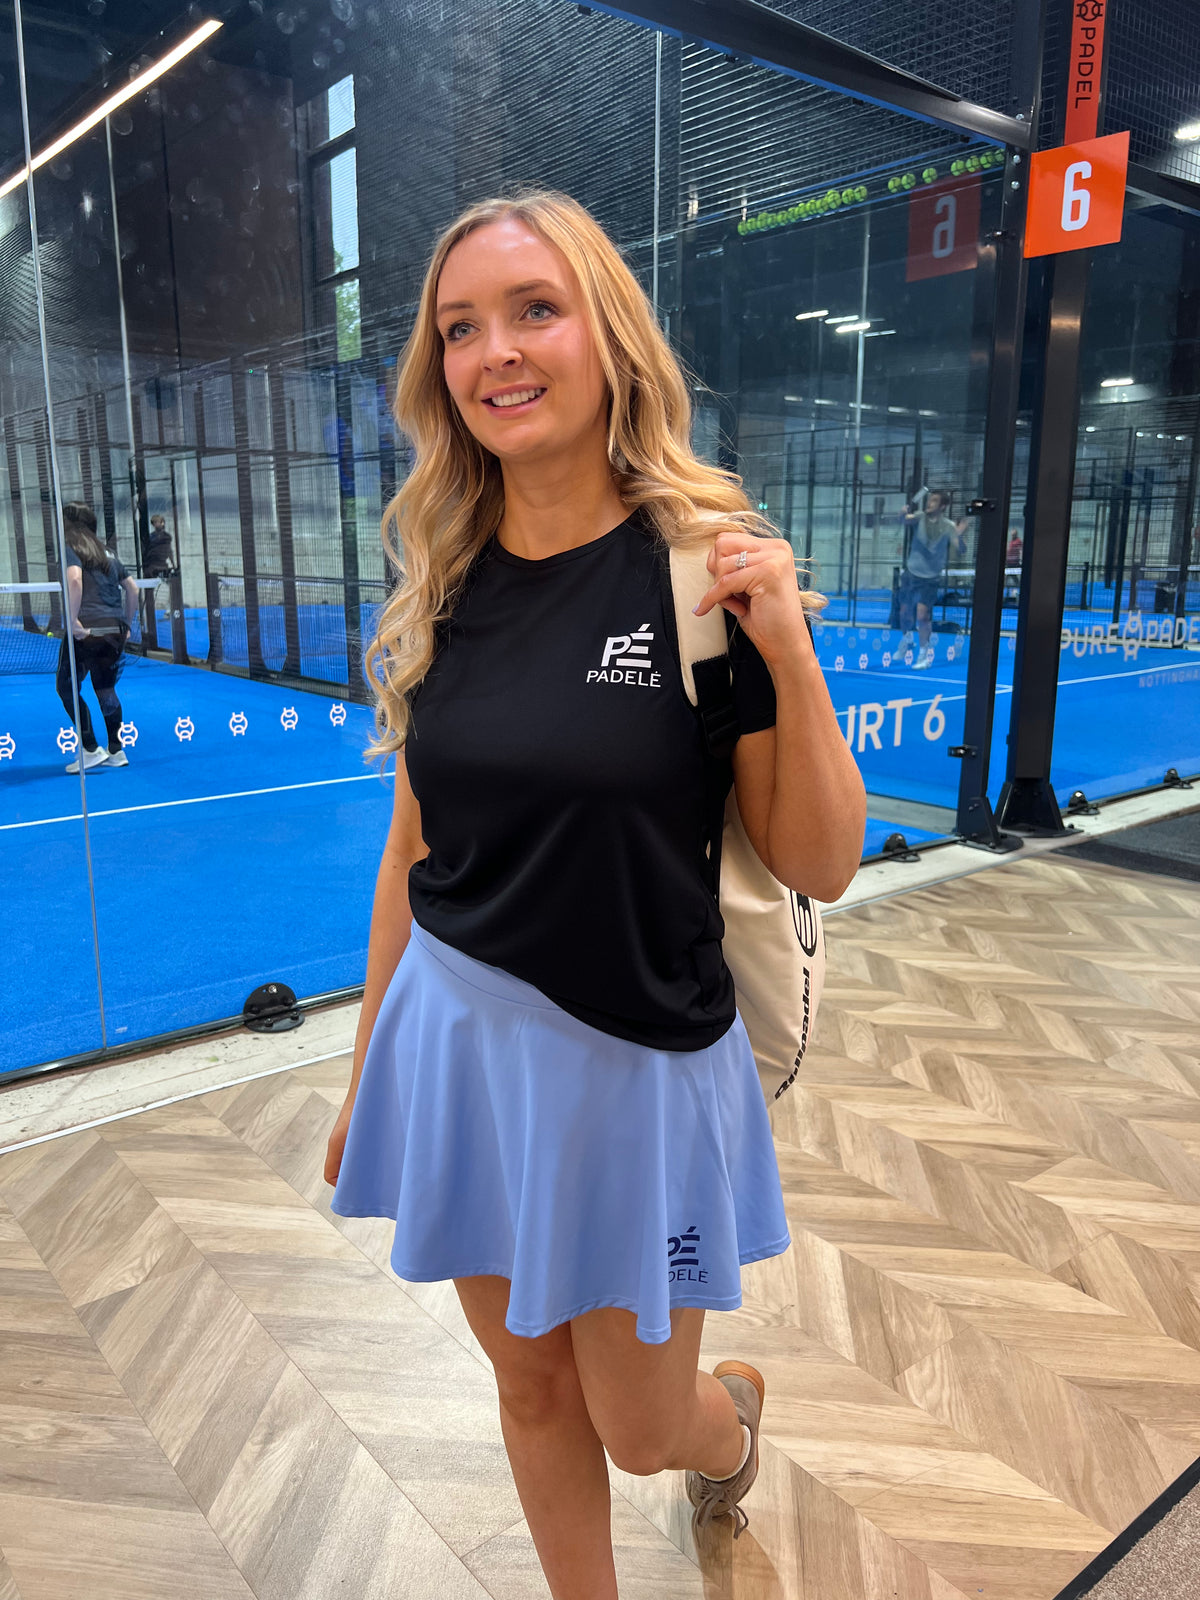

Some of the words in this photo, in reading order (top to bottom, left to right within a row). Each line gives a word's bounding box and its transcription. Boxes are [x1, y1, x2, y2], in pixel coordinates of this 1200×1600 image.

[1074, 27, 1096, 109] PADEL
[1061, 160, 1092, 232] 6
[1060, 622, 1119, 658] PURE
[923, 693, 946, 741] 6
